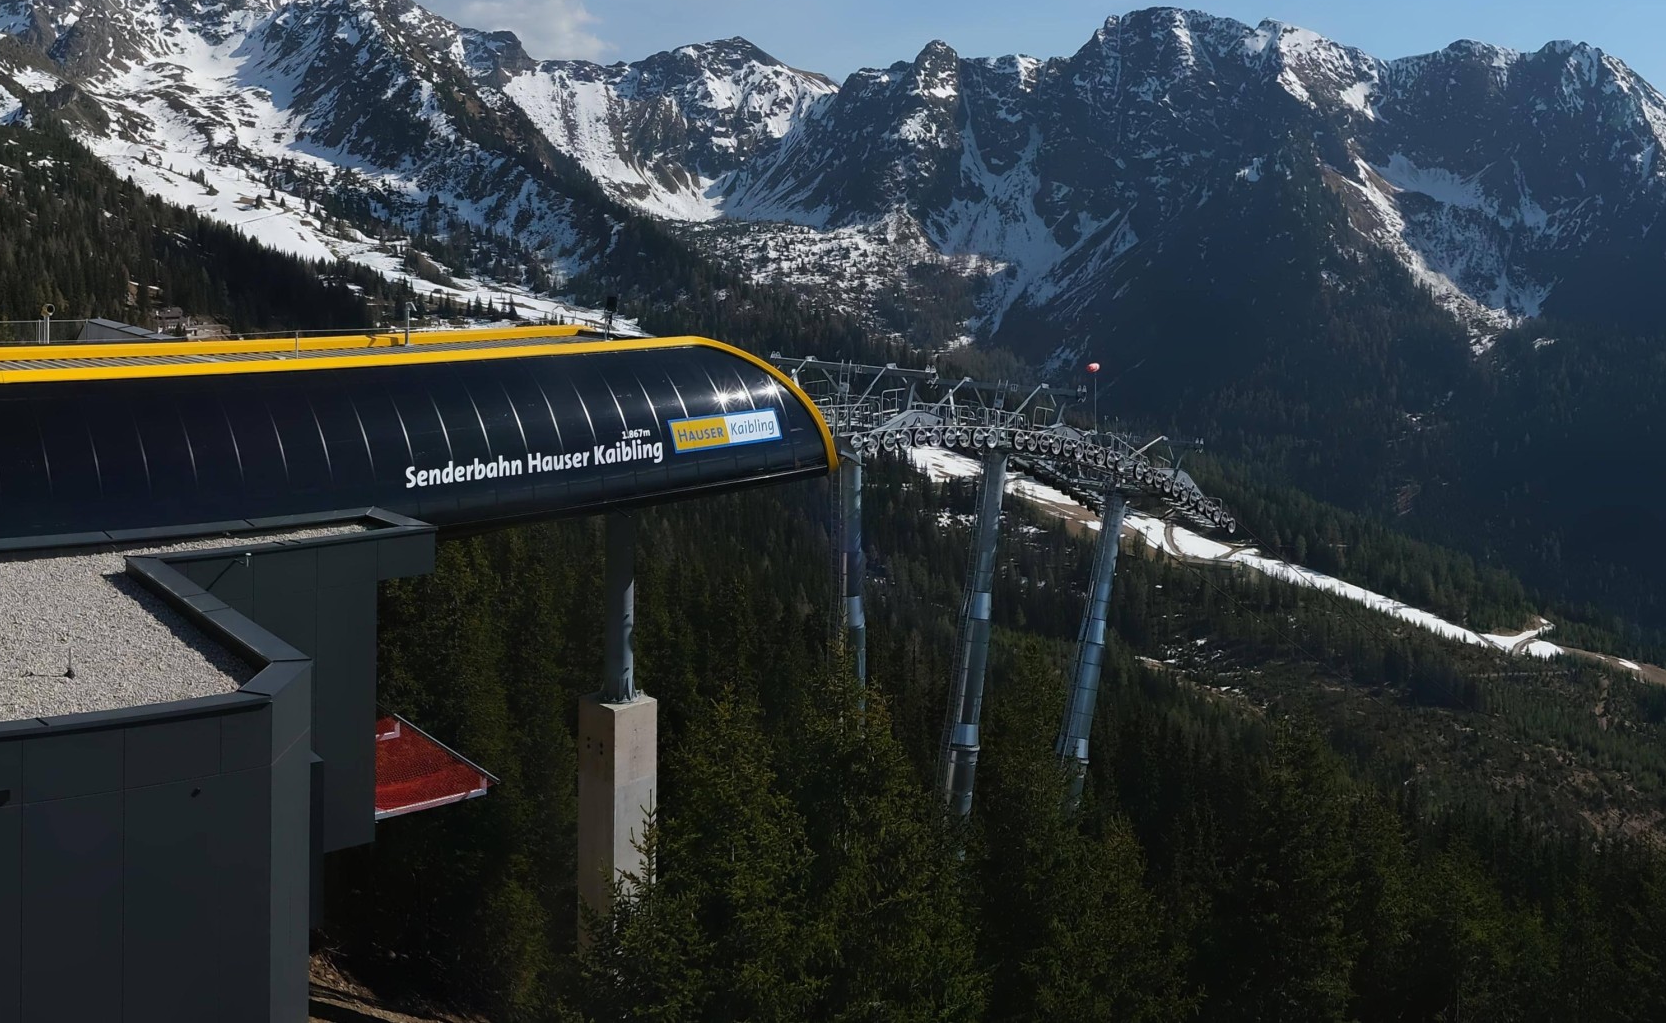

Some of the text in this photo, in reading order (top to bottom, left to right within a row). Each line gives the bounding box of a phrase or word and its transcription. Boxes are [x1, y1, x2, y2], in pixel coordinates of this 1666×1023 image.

[621, 428, 651, 440] 1.867m
[678, 417, 775, 443] HAUSER Kaibling
[405, 439, 663, 489] Senderbahn Hauser Kaibling
